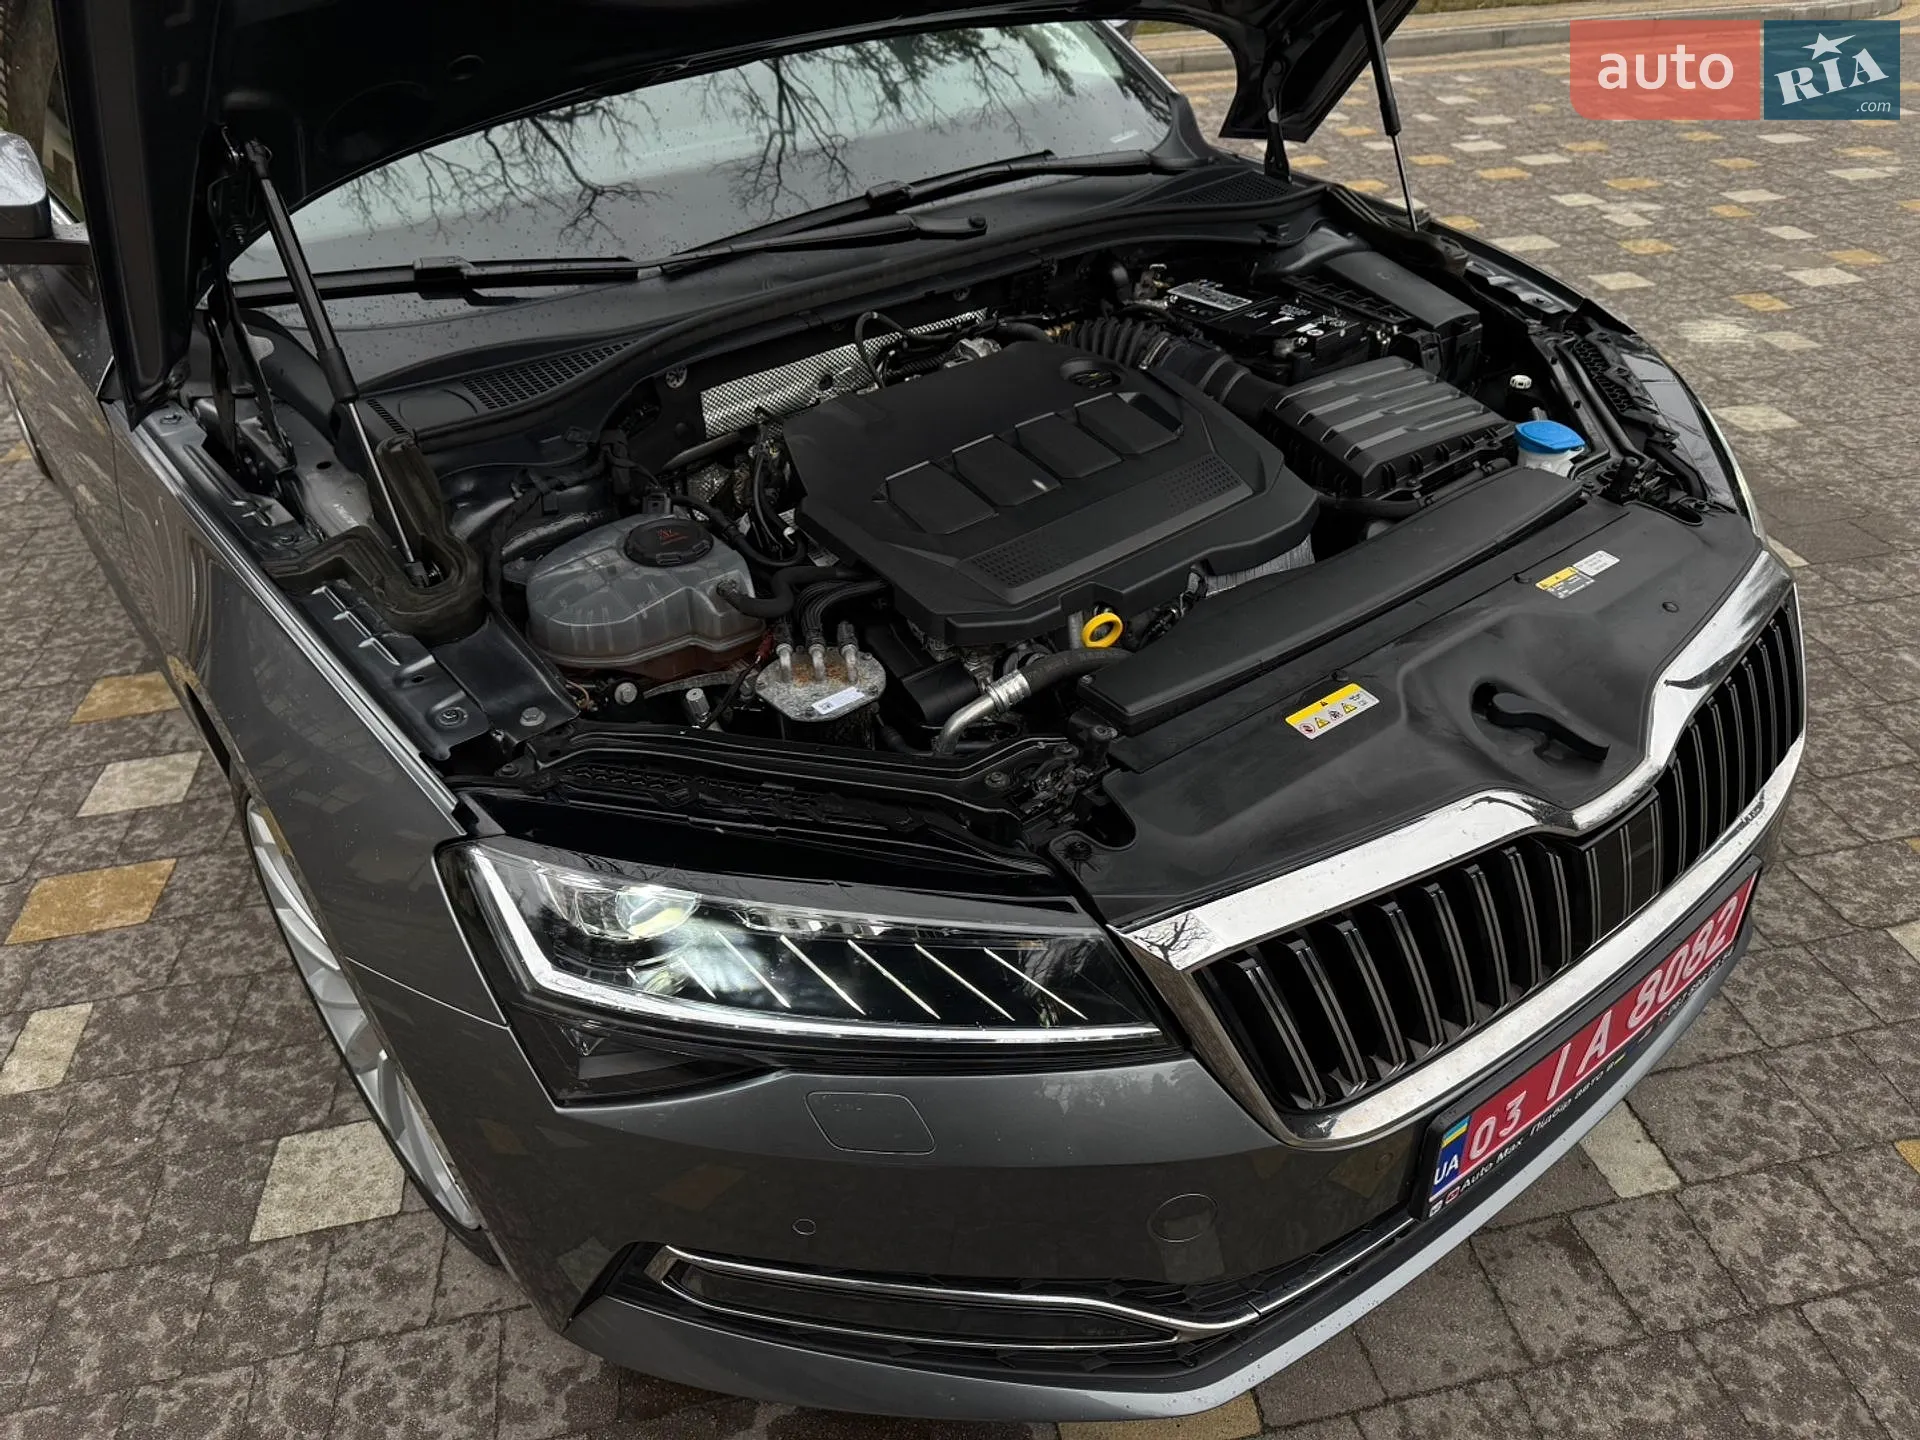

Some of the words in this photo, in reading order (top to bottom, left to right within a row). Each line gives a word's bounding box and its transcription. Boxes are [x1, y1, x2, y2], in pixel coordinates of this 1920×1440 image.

[1468, 1089, 1528, 1161] 03
[1546, 1008, 1614, 1102] IA
[1626, 895, 1739, 1030] 8082
[1433, 1153, 1460, 1186] UA
[1460, 1162, 1494, 1192] Auto
